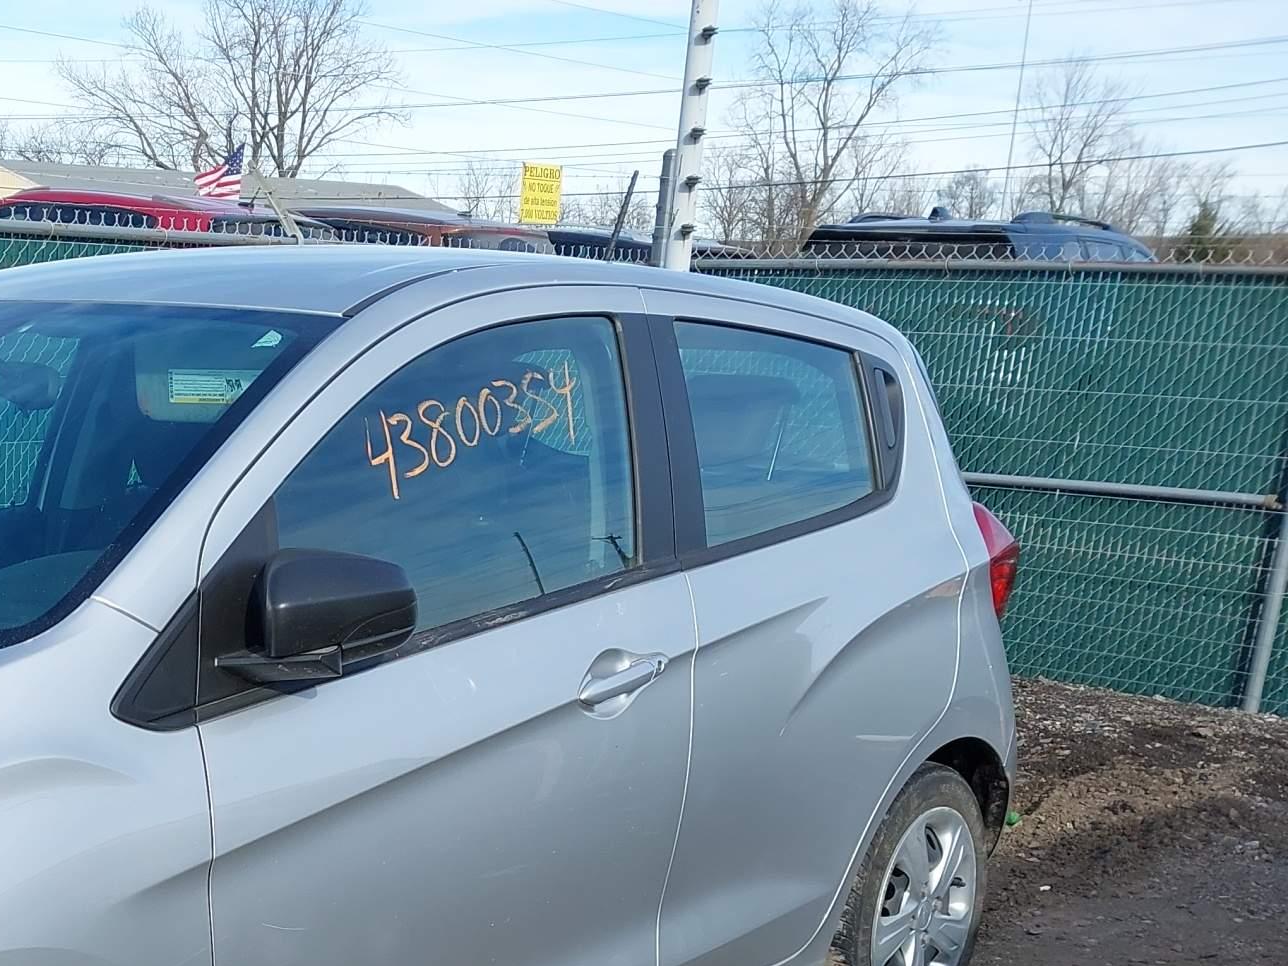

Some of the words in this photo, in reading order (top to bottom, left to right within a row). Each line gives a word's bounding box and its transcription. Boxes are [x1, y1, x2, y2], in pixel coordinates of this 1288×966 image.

[524, 166, 561, 180] PELIGRO
[528, 182, 536, 193] NO
[537, 183, 553, 193] TOQUE
[363, 360, 578, 501] 43800354
